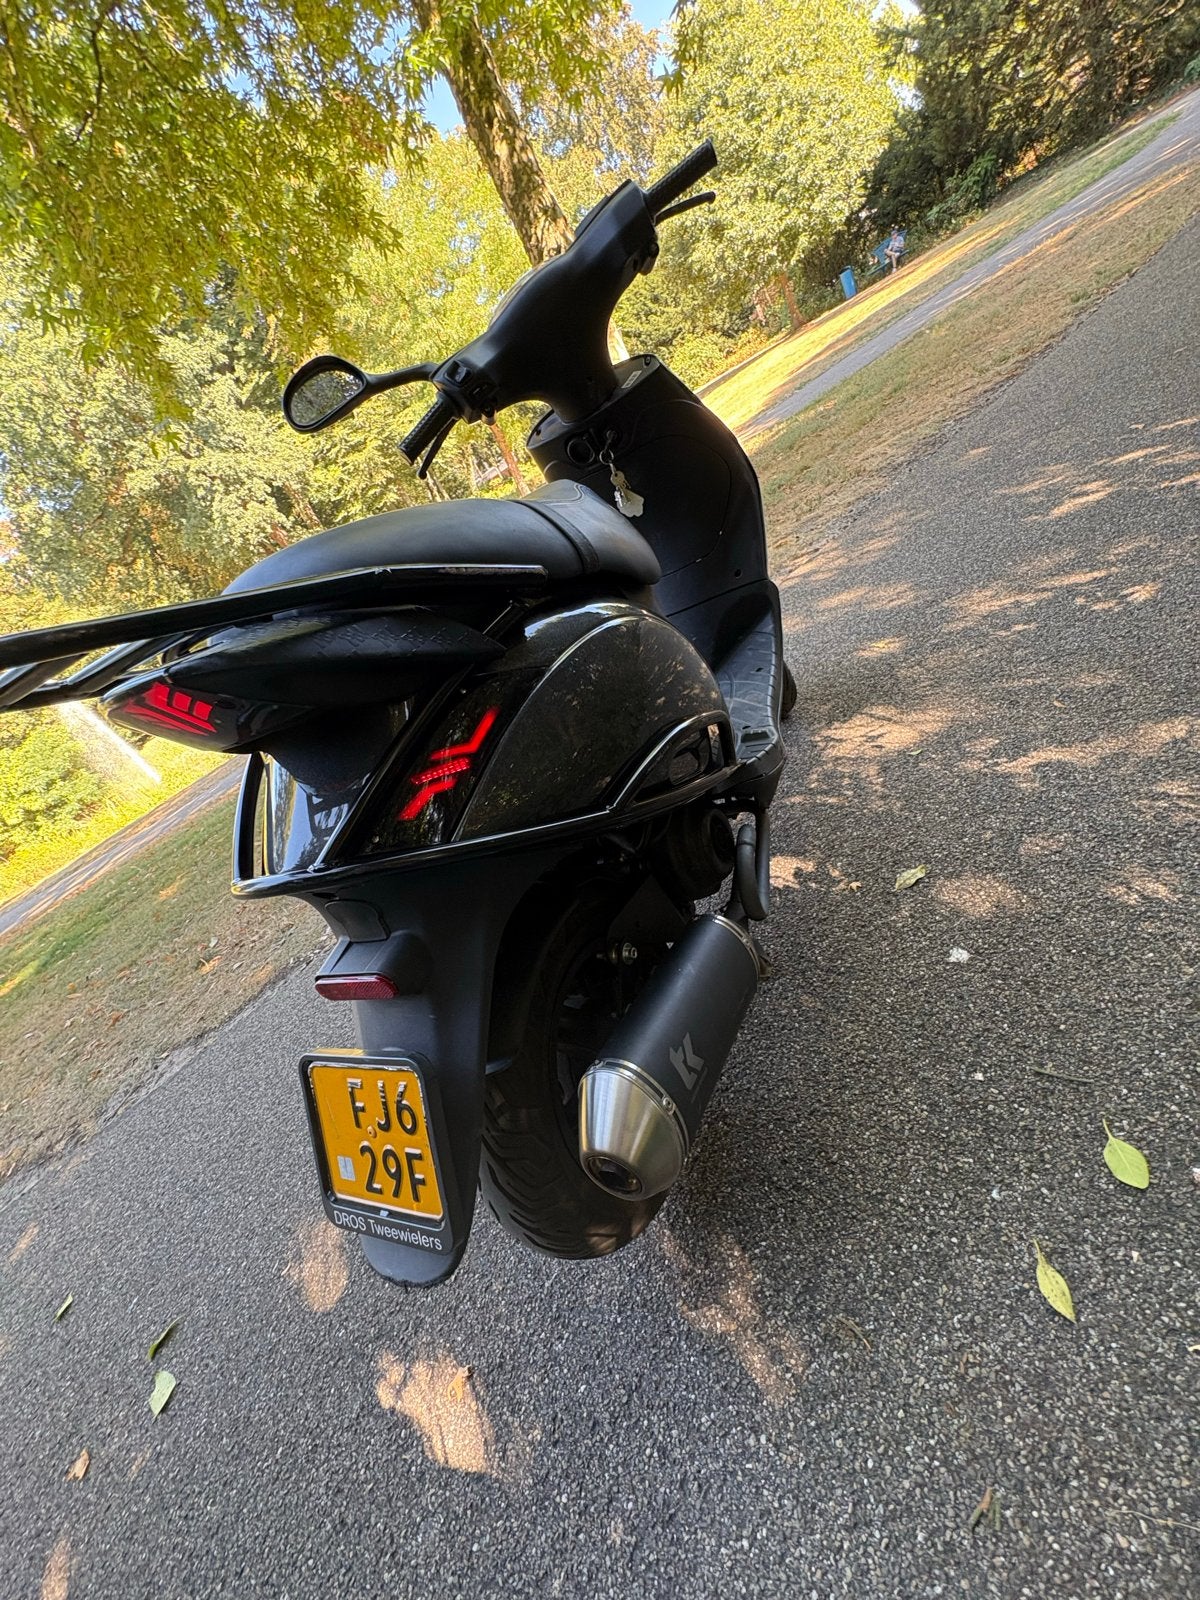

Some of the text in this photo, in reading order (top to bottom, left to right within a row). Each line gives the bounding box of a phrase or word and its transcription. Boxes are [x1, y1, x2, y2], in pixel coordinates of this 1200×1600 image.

[346, 1078, 417, 1135] FJ6
[359, 1140, 426, 1203] 29F
[333, 1210, 443, 1251] DROS Tweewielers
